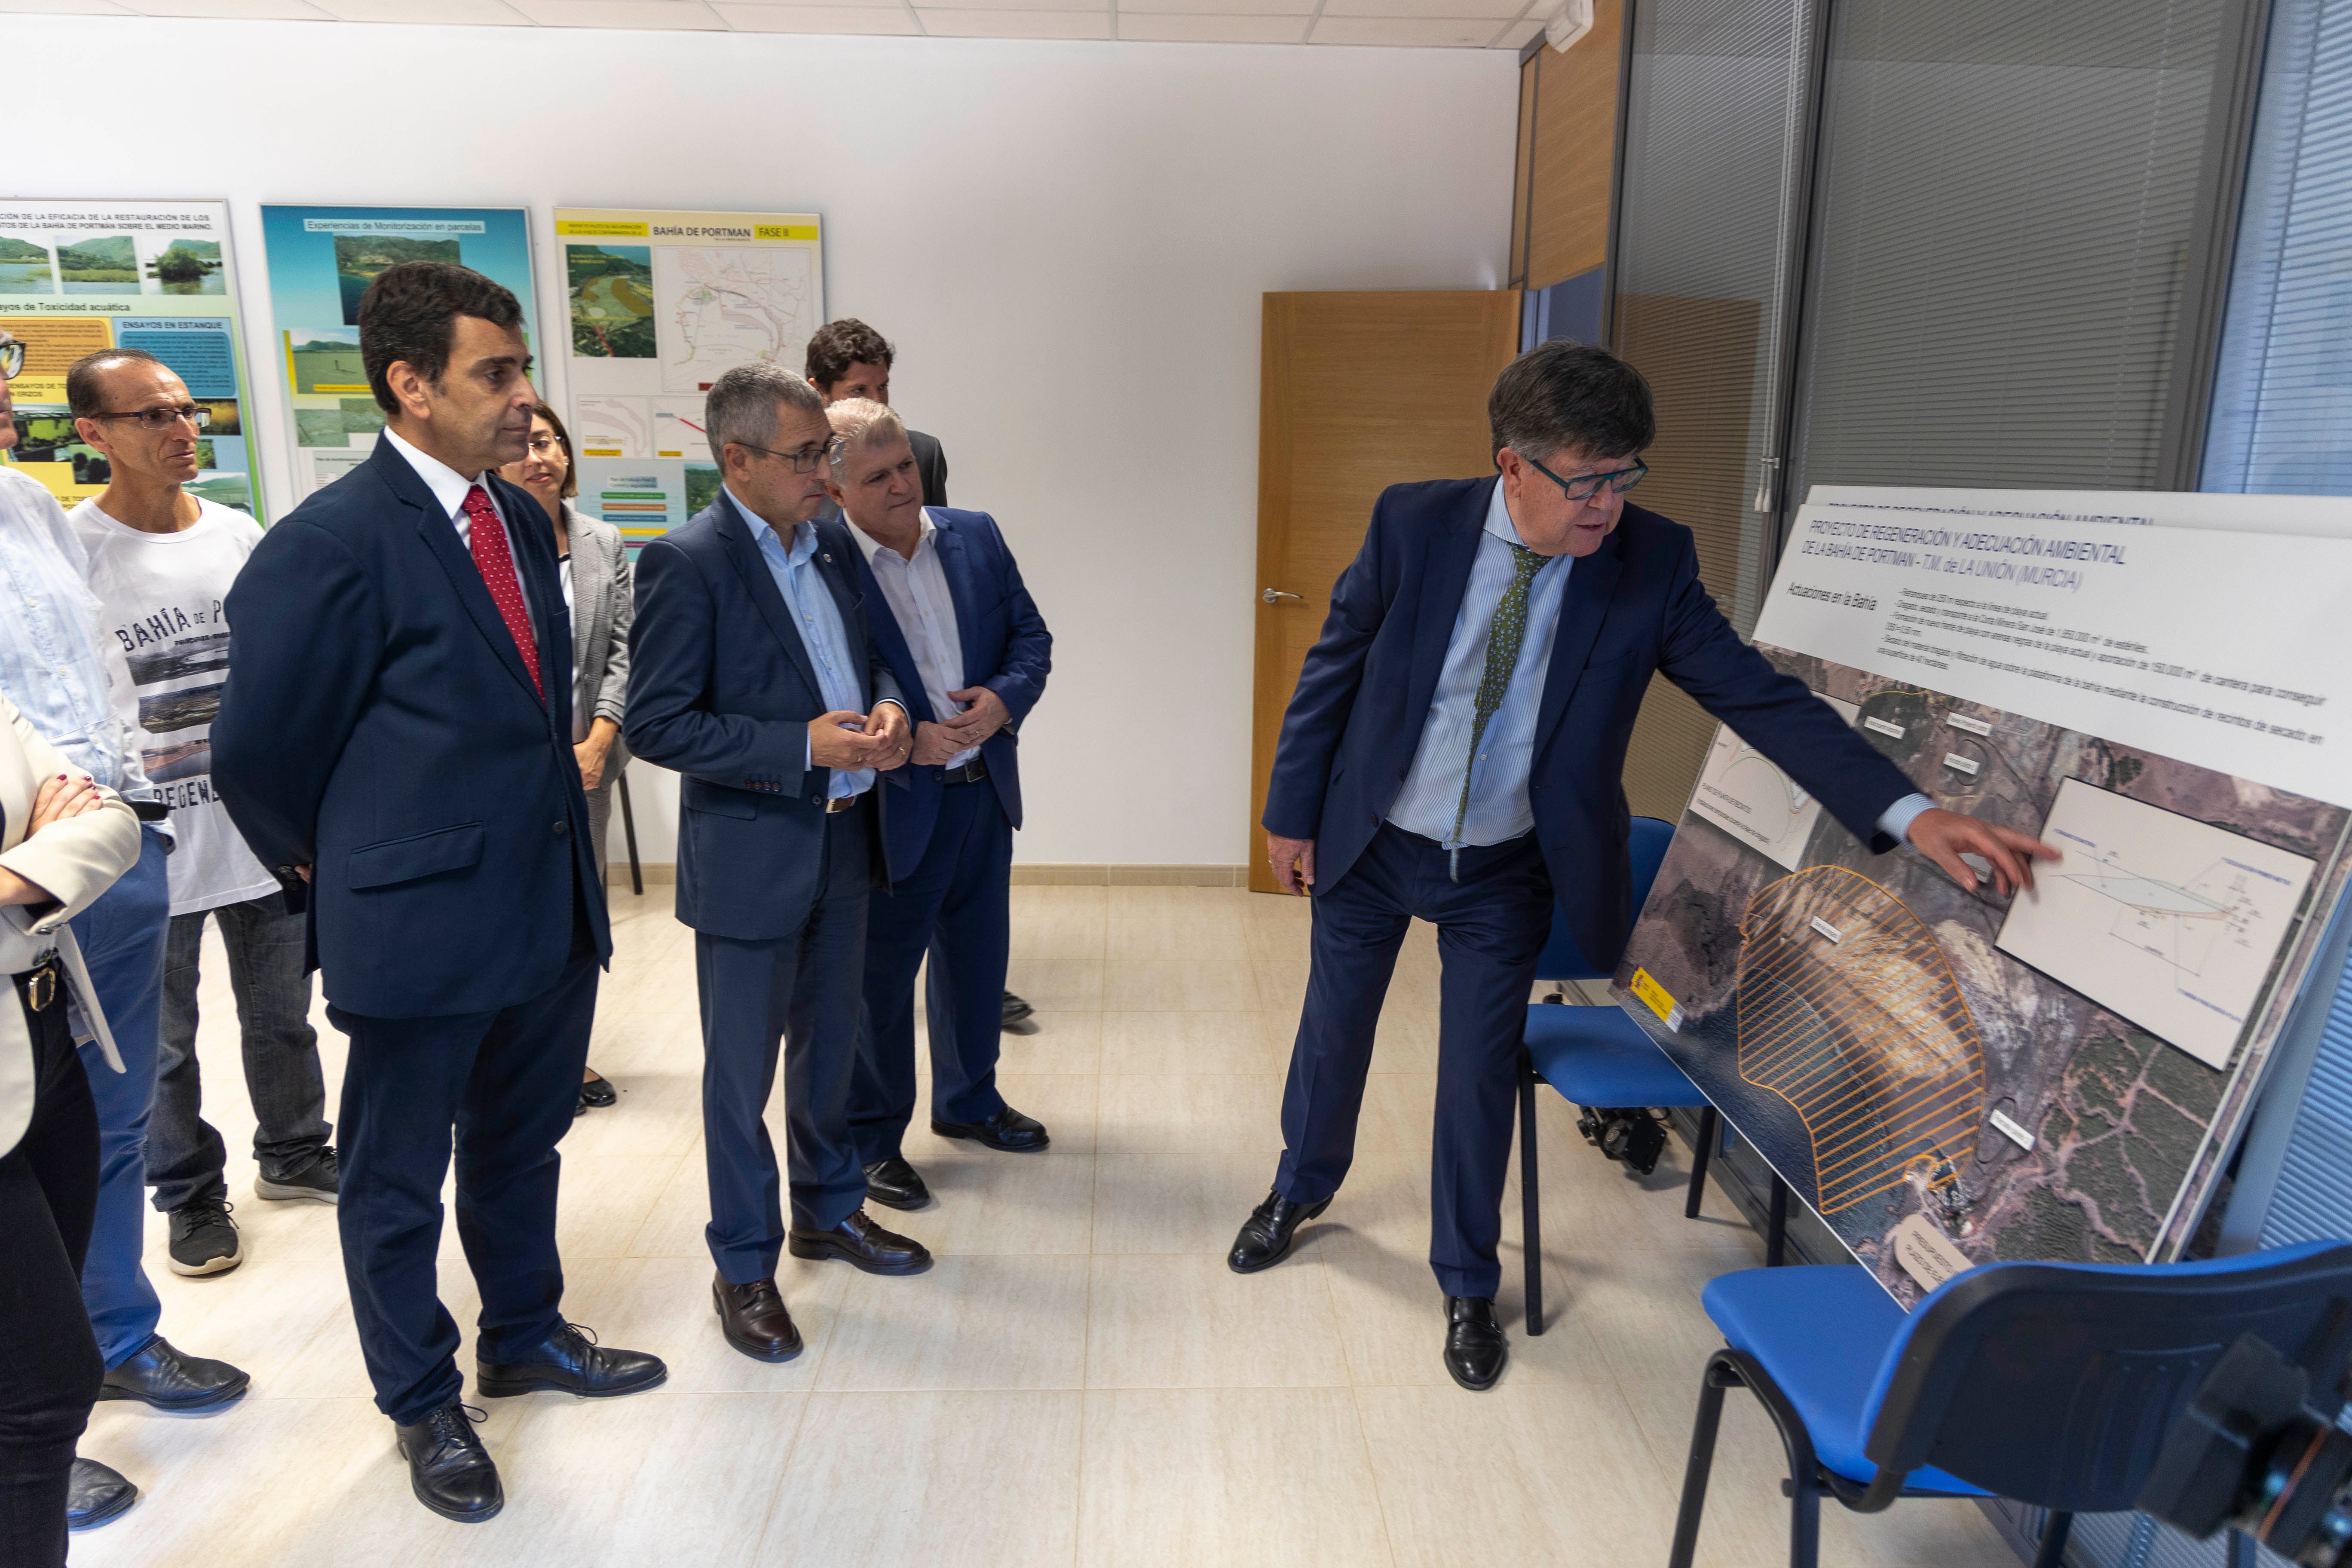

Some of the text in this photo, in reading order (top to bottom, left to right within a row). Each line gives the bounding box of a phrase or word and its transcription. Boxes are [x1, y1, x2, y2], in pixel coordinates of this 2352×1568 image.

[307, 221, 360, 230] Experiencias
[362, 222, 372, 230] de
[374, 221, 433, 230] Monitorización
[447, 223, 482, 232] parcelas
[653, 225, 684, 236] BAHÍA
[687, 228, 699, 236] DE
[701, 228, 751, 238] PORTMAN
[759, 228, 789, 238] FASE II
[23, 303, 36, 311] de
[37, 303, 86, 311] Toxicidad
[89, 303, 131, 312] acuática
[1809, 521, 2130, 564] PROYECTO DE REGENERACIÓN Y ADECUACIÓN AMBIENTAL
[1801, 541, 1815, 554] DE
[1814, 542, 1826, 555] LA
[1825, 540, 1853, 558] BAHÍA
[1852, 546, 1867, 560] DE
[1866, 548, 1916, 567] PORTMAN
[1942, 557, 1959, 573] de
[1958, 558, 1976, 575] LA
[1974, 556, 2019, 580] UNIÓN
[2015, 565, 2085, 594] (MURCIA)
[1787, 582, 1878, 610] Actuaciones en la Bahía
[115, 607, 191, 652] BAHÍA
[193, 612, 205, 624] DE
[2103, 637, 2114, 647] de
[2138, 659, 2149, 670] de
[2200, 671, 2213, 683] de
[2214, 674, 2249, 690] cantera
[2248, 683, 2273, 698] para
[2274, 686, 2328, 709] conseguir
[2063, 675, 2073, 686] de
[2073, 677, 2081, 687] la
[2080, 679, 2103, 692] bahía
[2103, 684, 2139, 701] mediante
[2138, 692, 2148, 703] la
[2147, 694, 2201, 715] construcción
[2201, 707, 2214, 719] de
[2214, 710, 2254, 728] recintos
[2254, 718, 2269, 732] de
[2268, 722, 2307, 741] secado
[2306, 733, 2324, 745] en
